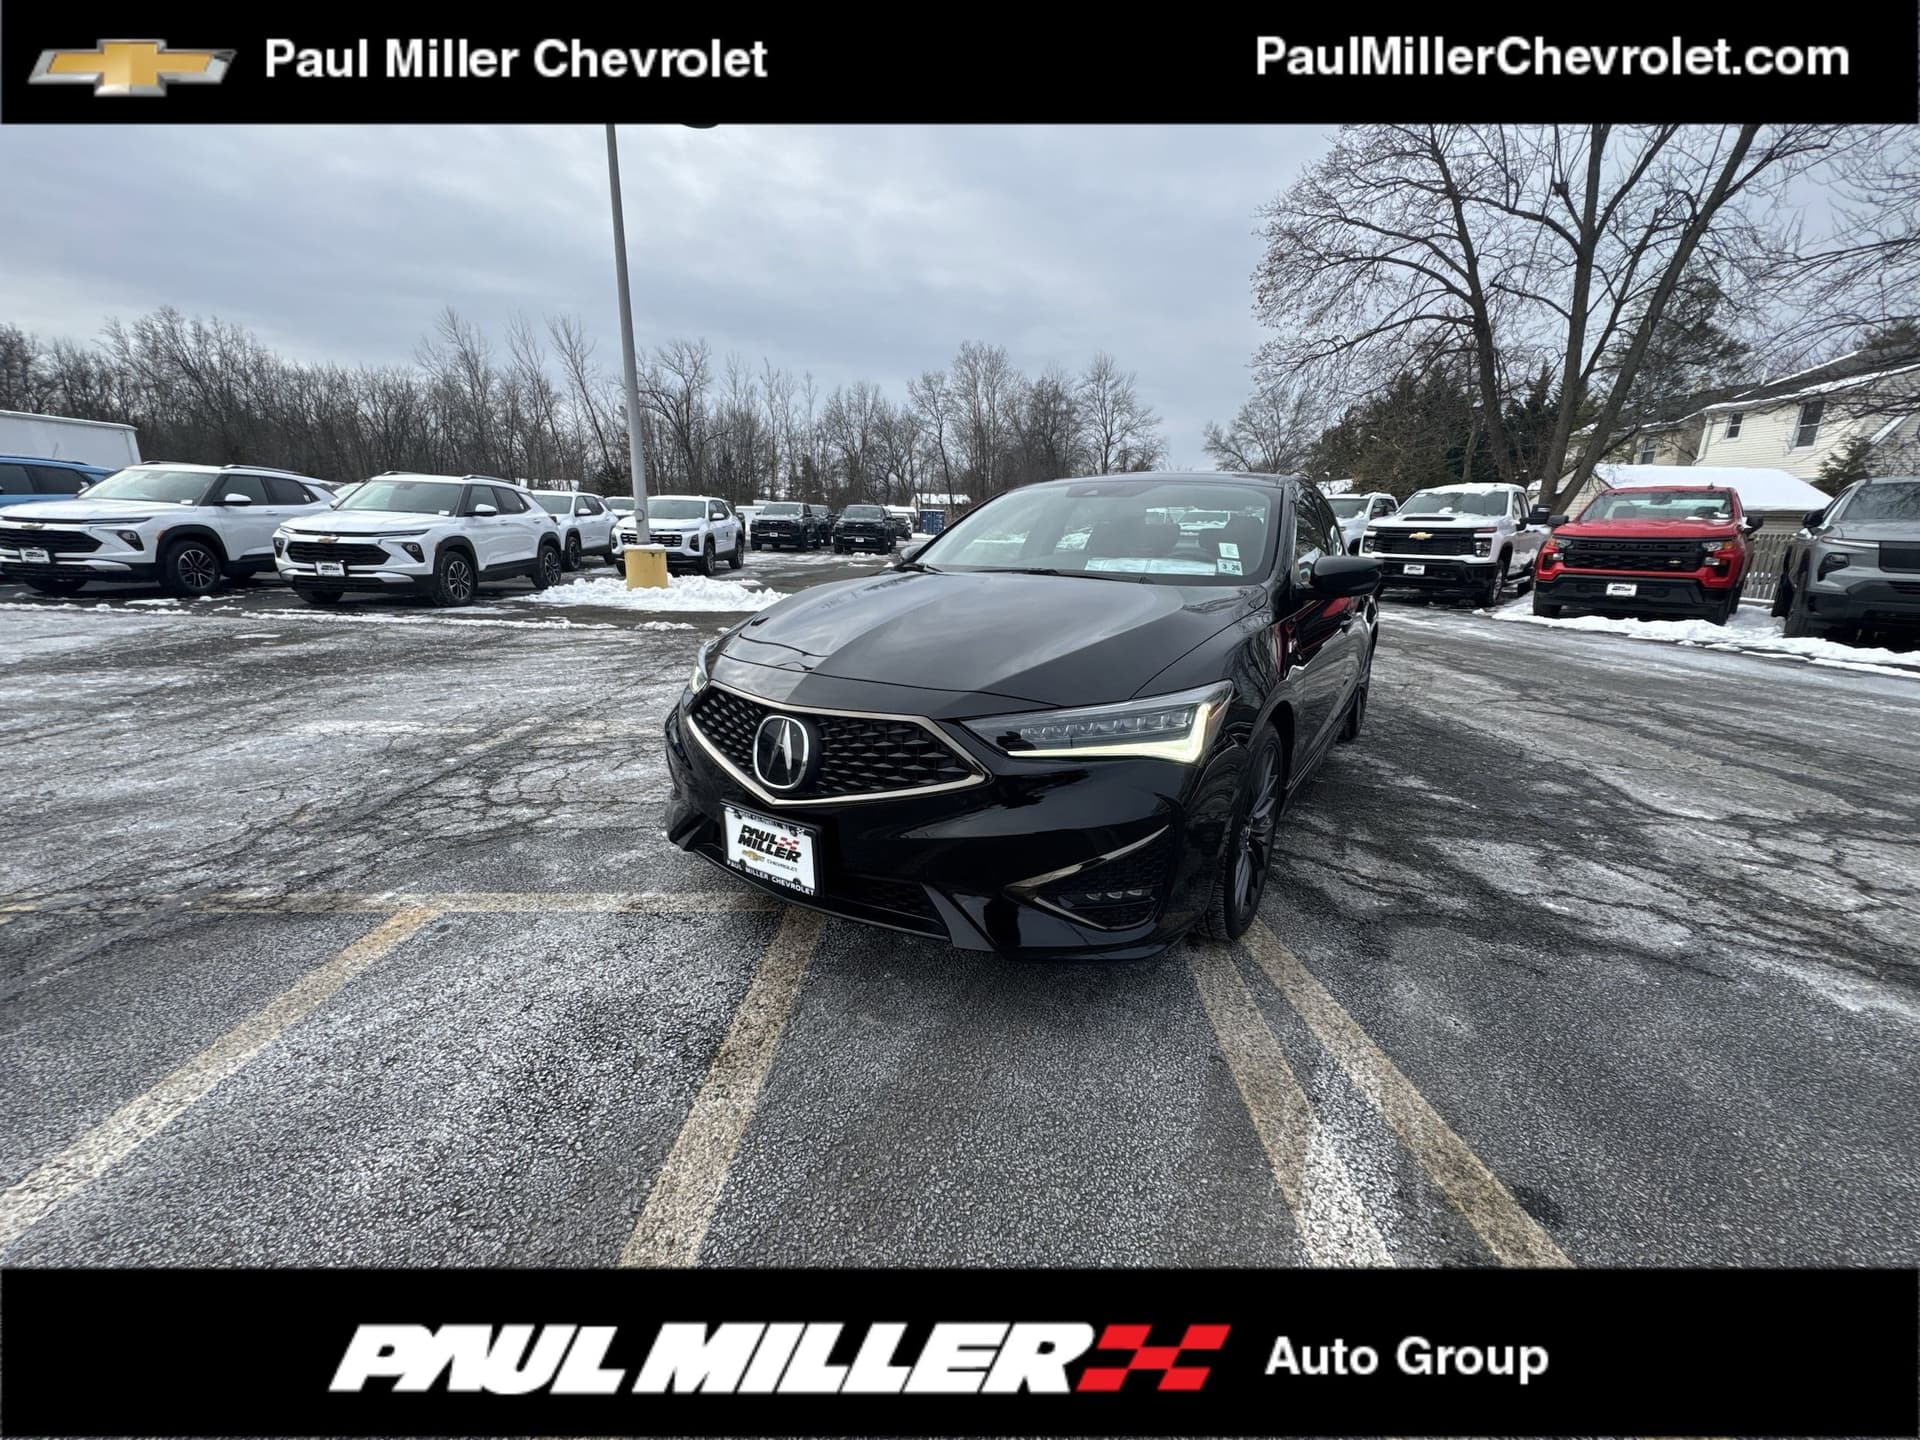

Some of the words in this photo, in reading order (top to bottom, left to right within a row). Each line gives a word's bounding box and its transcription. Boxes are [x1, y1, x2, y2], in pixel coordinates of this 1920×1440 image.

[738, 834, 801, 864] MILLER
[741, 824, 780, 845] PAUL
[727, 860, 743, 871] PAUL
[745, 865, 769, 881] MILLER
[771, 876, 815, 896] CHEVROLET
